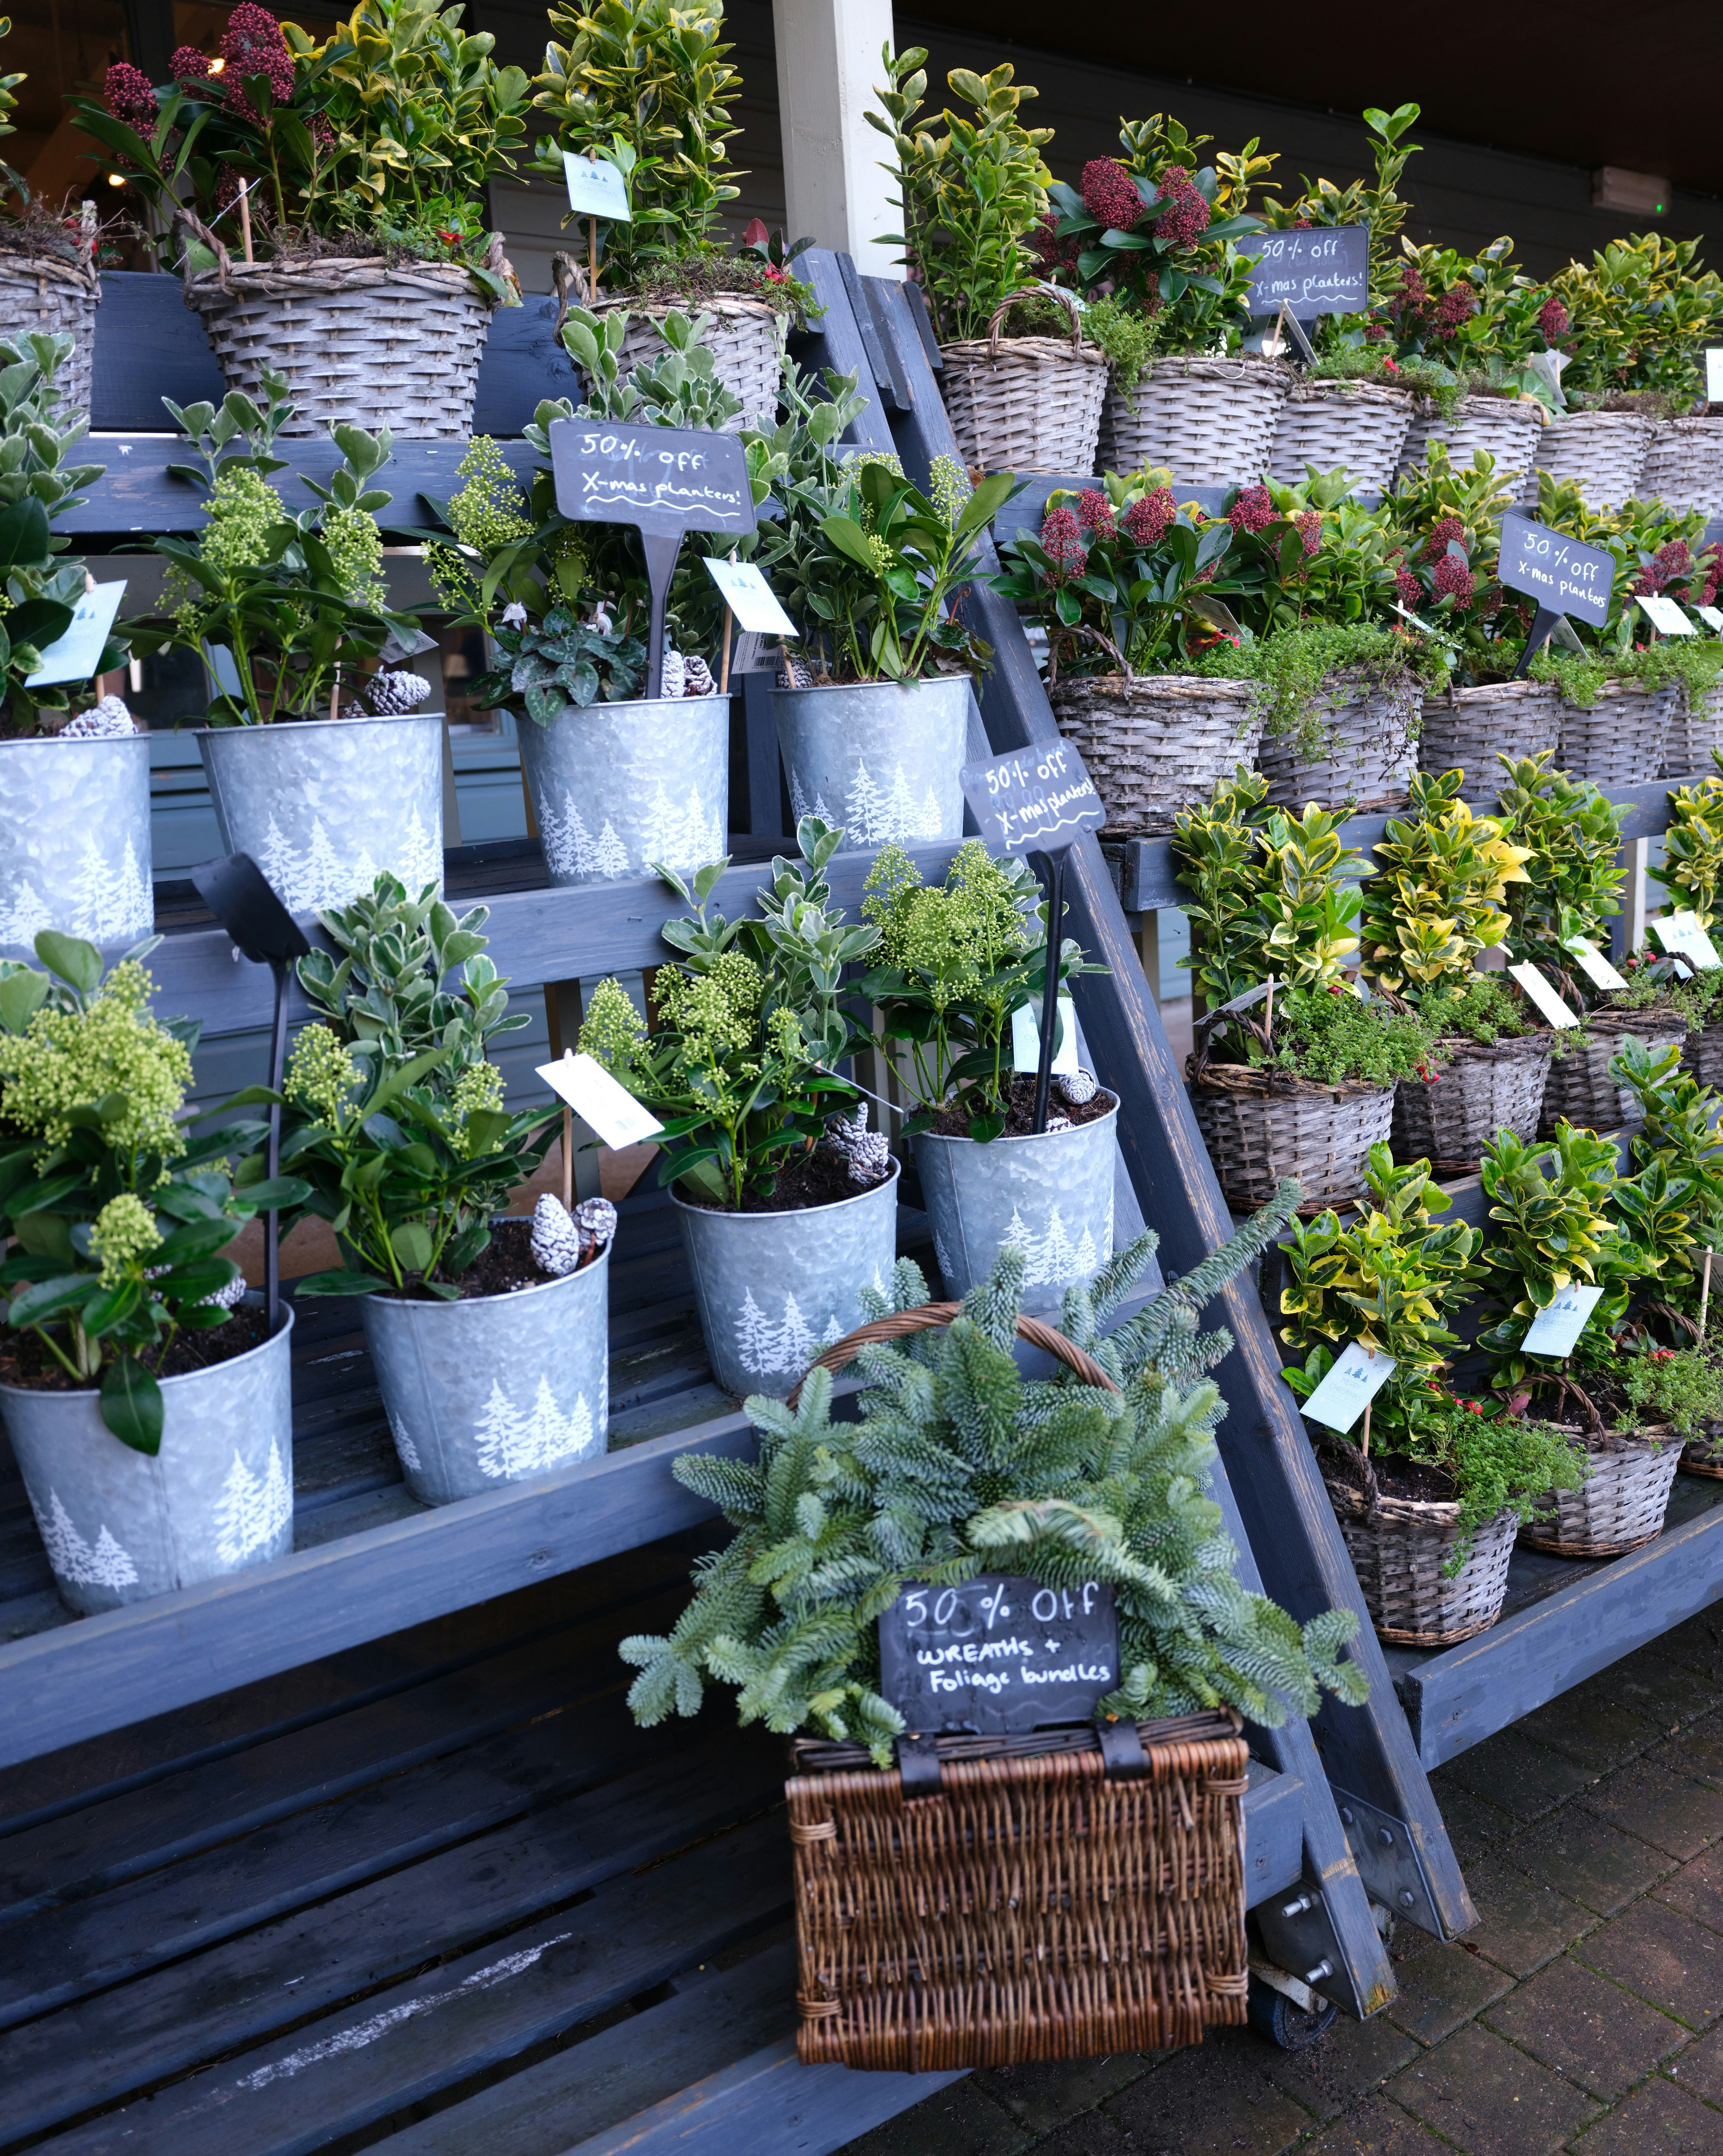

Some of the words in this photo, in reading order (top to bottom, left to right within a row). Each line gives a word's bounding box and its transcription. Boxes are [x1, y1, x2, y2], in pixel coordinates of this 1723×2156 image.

[578, 185, 617, 197] CHRISTMAS
[585, 180, 607, 188] MERRY
[1262, 238, 1302, 259] 50%
[1311, 240, 1338, 257] off
[581, 433, 641, 460] 50%
[659, 452, 704, 471] off
[656, 481, 741, 505] planters!
[1524, 533, 1569, 567] 50%
[1571, 562, 1599, 581] off
[985, 760, 1029, 794] 50%
[1037, 751, 1067, 779] off
[1543, 1319, 1576, 1328] CHRISTMAS
[1329, 1383, 1362, 1402] CHRISTMAS
[1340, 1377, 1362, 1390] MERRY
[930, 1670, 1010, 1694] Foliage
[1020, 1663, 1111, 1683] bundles
